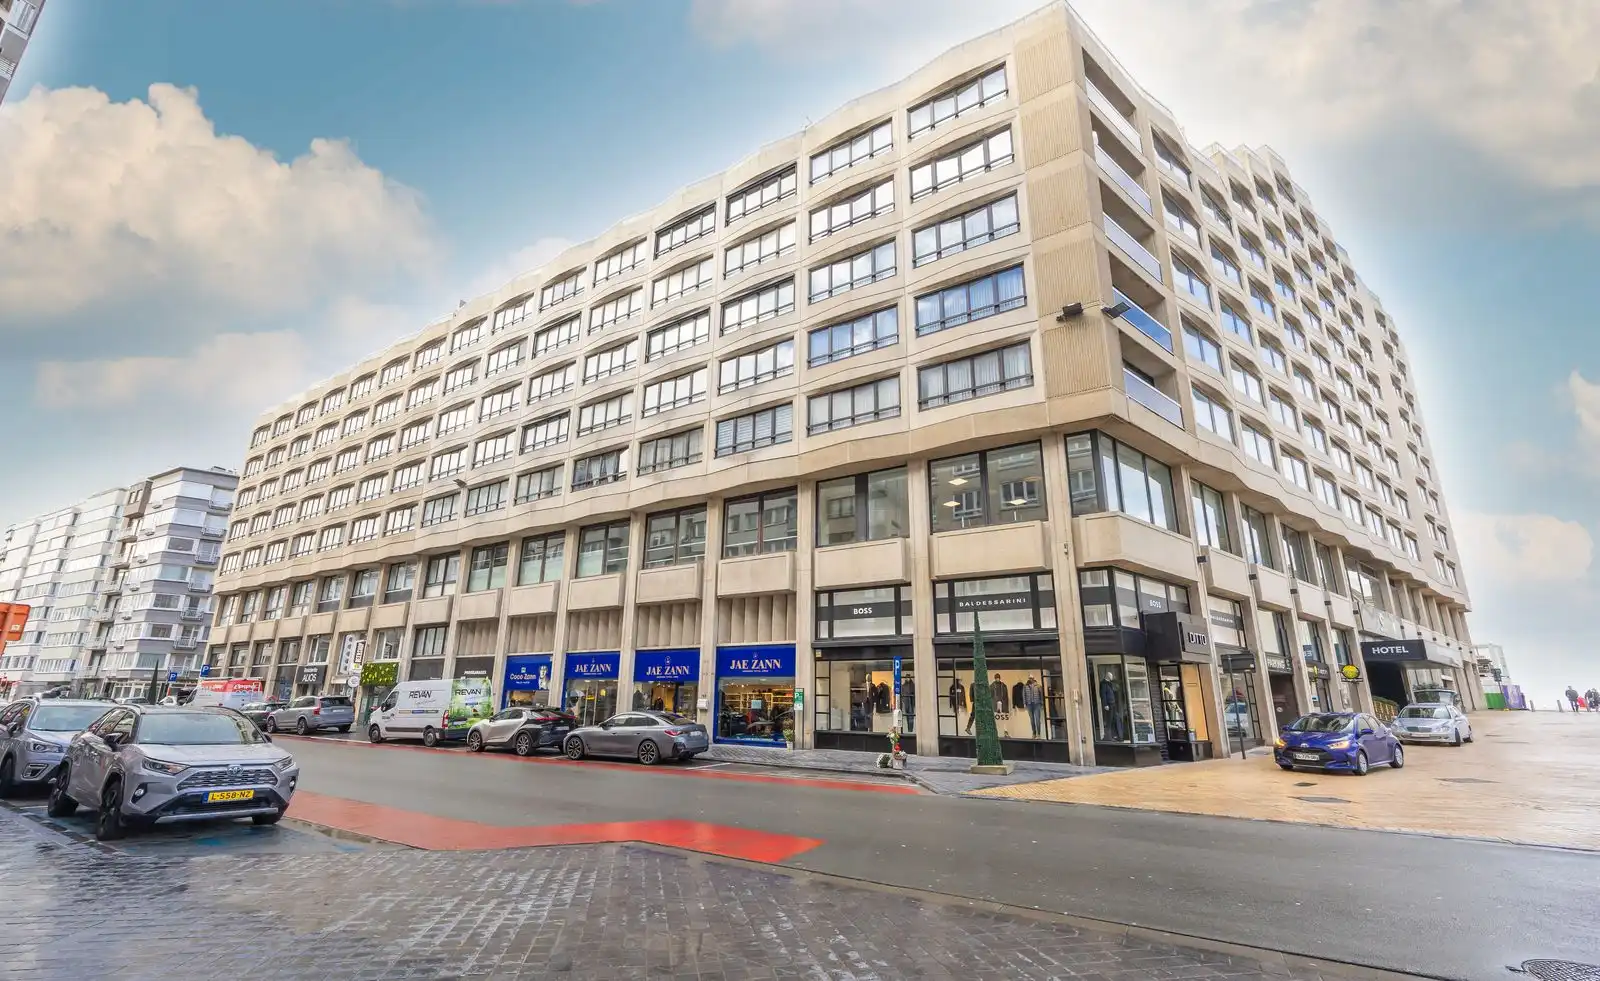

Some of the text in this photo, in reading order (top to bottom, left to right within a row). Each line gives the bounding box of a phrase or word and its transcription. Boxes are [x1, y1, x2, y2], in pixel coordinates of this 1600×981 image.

[959, 597, 1027, 607] BALDESSARINI
[853, 607, 873, 615] BOSS
[1188, 632, 1207, 646] DITTO
[1371, 645, 1409, 654] HOTEL
[574, 663, 612, 673] JAE ZANN
[730, 659, 782, 670] JAE ZANN
[646, 665, 690, 676] JAE ZANN
[408, 690, 432, 699] REVAN
[454, 688, 482, 696] REVAN
[211, 791, 251, 801] L-558-NZ
